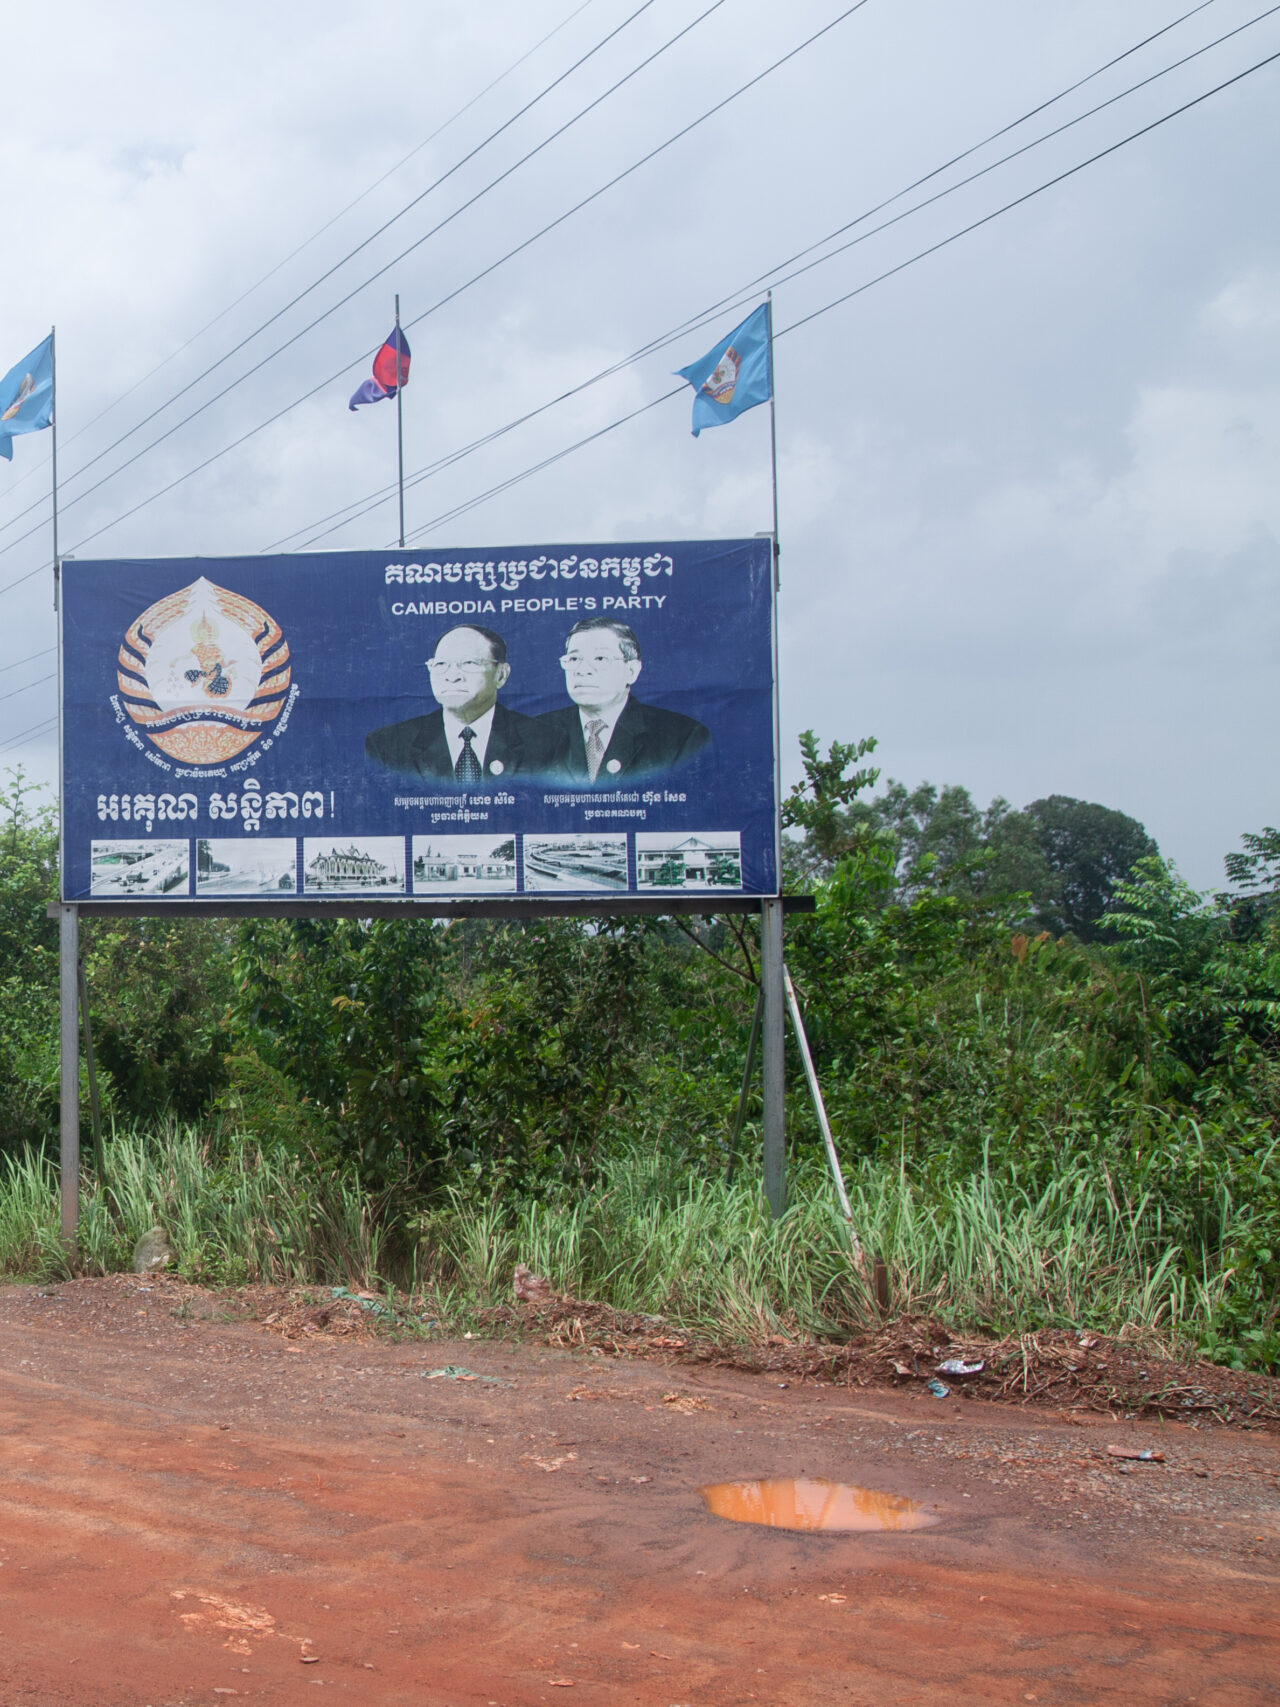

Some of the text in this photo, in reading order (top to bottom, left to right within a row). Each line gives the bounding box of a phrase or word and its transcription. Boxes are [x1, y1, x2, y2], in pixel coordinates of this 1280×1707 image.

[384, 552, 674, 595] គណបក្សប្រជាជនកម្ពុជា
[391, 600, 496, 616] CAMBODIA
[603, 595, 667, 610] PARTY
[664, 790, 687, 803] សែន
[97, 793, 198, 833] អរគុណ
